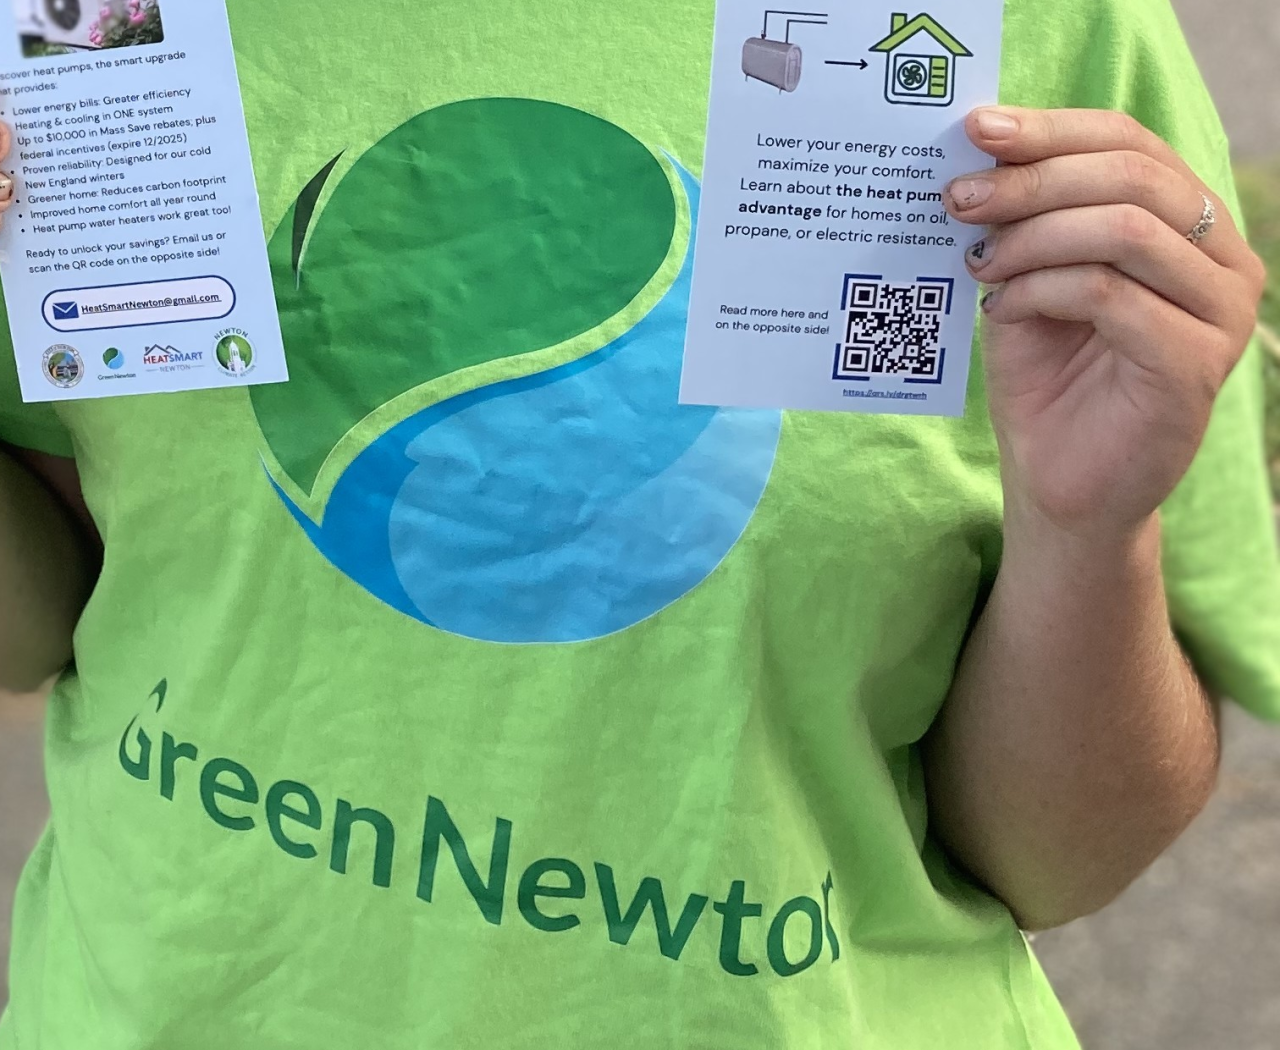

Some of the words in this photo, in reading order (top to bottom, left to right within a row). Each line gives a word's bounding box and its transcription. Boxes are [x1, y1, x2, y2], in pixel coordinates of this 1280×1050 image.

[33, 66, 55, 76] heat
[57, 63, 93, 76] pumps,
[95, 60, 112, 69] the
[114, 56, 143, 67] smart
[145, 50, 186, 65] upgrade
[12, 106, 41, 116] Lower
[43, 102, 77, 112] energy
[102, 94, 140, 106] Greater
[142, 88, 191, 101] efficiency
[15, 119, 52, 131] Heating
[54, 117, 63, 126] &
[64, 113, 100, 125] cooling
[102, 112, 112, 121] in
[113, 107, 135, 119] ONE
[137, 105, 174, 118] system
[17, 136, 31, 147] Up
[33, 136, 44, 144] to
[46, 129, 87, 143] $10,000
[88, 129, 98, 137] in
[99, 126, 126, 136] Mass
[127, 123, 151, 133] Save
[195, 115, 216, 128] plus
[20, 148, 54, 160] federal
[56, 144, 106, 156] incentives
[107, 139, 142, 153] (expire
[143, 132, 187, 147] 12/2025)
[757, 133, 803, 149] Lower
[806, 139, 841, 153] your
[844, 142, 897, 158] energy
[901, 145, 945, 159] costs,
[22, 165, 56, 175] Proven
[105, 152, 152, 167] Designed
[154, 151, 168, 160] for
[170, 150, 186, 159] our
[189, 145, 212, 157] cold
[758, 157, 829, 174] maximize
[834, 164, 868, 177] your
[872, 164, 935, 180] comfort.
[25, 180, 46, 190] New
[48, 174, 87, 189] England
[89, 172, 125, 183] winters
[27, 193, 66, 204] Greener
[101, 185, 144, 197] Reduces
[145, 181, 181, 192] carbon
[183, 175, 226, 188] footprint
[741, 177, 782, 193] Learn
[787, 180, 831, 196] about
[836, 183, 862, 198] the
[867, 184, 902, 200] heat
[905, 191, 944, 205] pum
[30, 205, 76, 220] Improved
[78, 204, 107, 214] home
[107, 199, 148, 211] comfort
[150, 196, 161, 207] all
[163, 196, 184, 208] year
[186, 191, 216, 203] round
[739, 200, 821, 221] advantage
[826, 204, 847, 219] for
[851, 206, 901, 222] homes
[907, 213, 925, 223] on
[930, 211, 948, 226] oil,
[33, 224, 55, 234] Heat
[58, 221, 87, 234] pump
[88, 218, 115, 228] water
[118, 214, 156, 225] heaters
[157, 210, 181, 222] work
[183, 208, 210, 221] great
[212, 205, 231, 215] too!
[26, 248, 56, 259] Ready
[58, 248, 69, 256] to
[70, 243, 103, 255] unlock
[105, 242, 126, 253] your
[129, 236, 170, 249] savings?
[172, 233, 200, 245] Email
[201, 233, 214, 242] us
[216, 232, 226, 240] or
[725, 224, 791, 240] propane,
[796, 229, 812, 239] or
[816, 226, 872, 243] electric
[877, 231, 956, 246] resistance.
[29, 264, 52, 273] scan
[53, 262, 70, 271] the
[72, 259, 87, 271] QR
[89, 257, 115, 268] code
[116, 257, 130, 266] on
[131, 254, 148, 264] the
[150, 250, 195, 264] opposite
[196, 246, 220, 258] side!
[720, 304, 747, 316] Read
[750, 308, 778, 317] more
[781, 308, 805, 319] here
[808, 310, 829, 320] and
[214, 327, 249, 340] NEWTON
[715, 321, 729, 329] on
[732, 320, 750, 331] the
[753, 323, 801, 334] opposite
[804, 324, 829, 335] side!
[143, 352, 203, 365] HEATSMART
[160, 364, 191, 372] NEWTON
